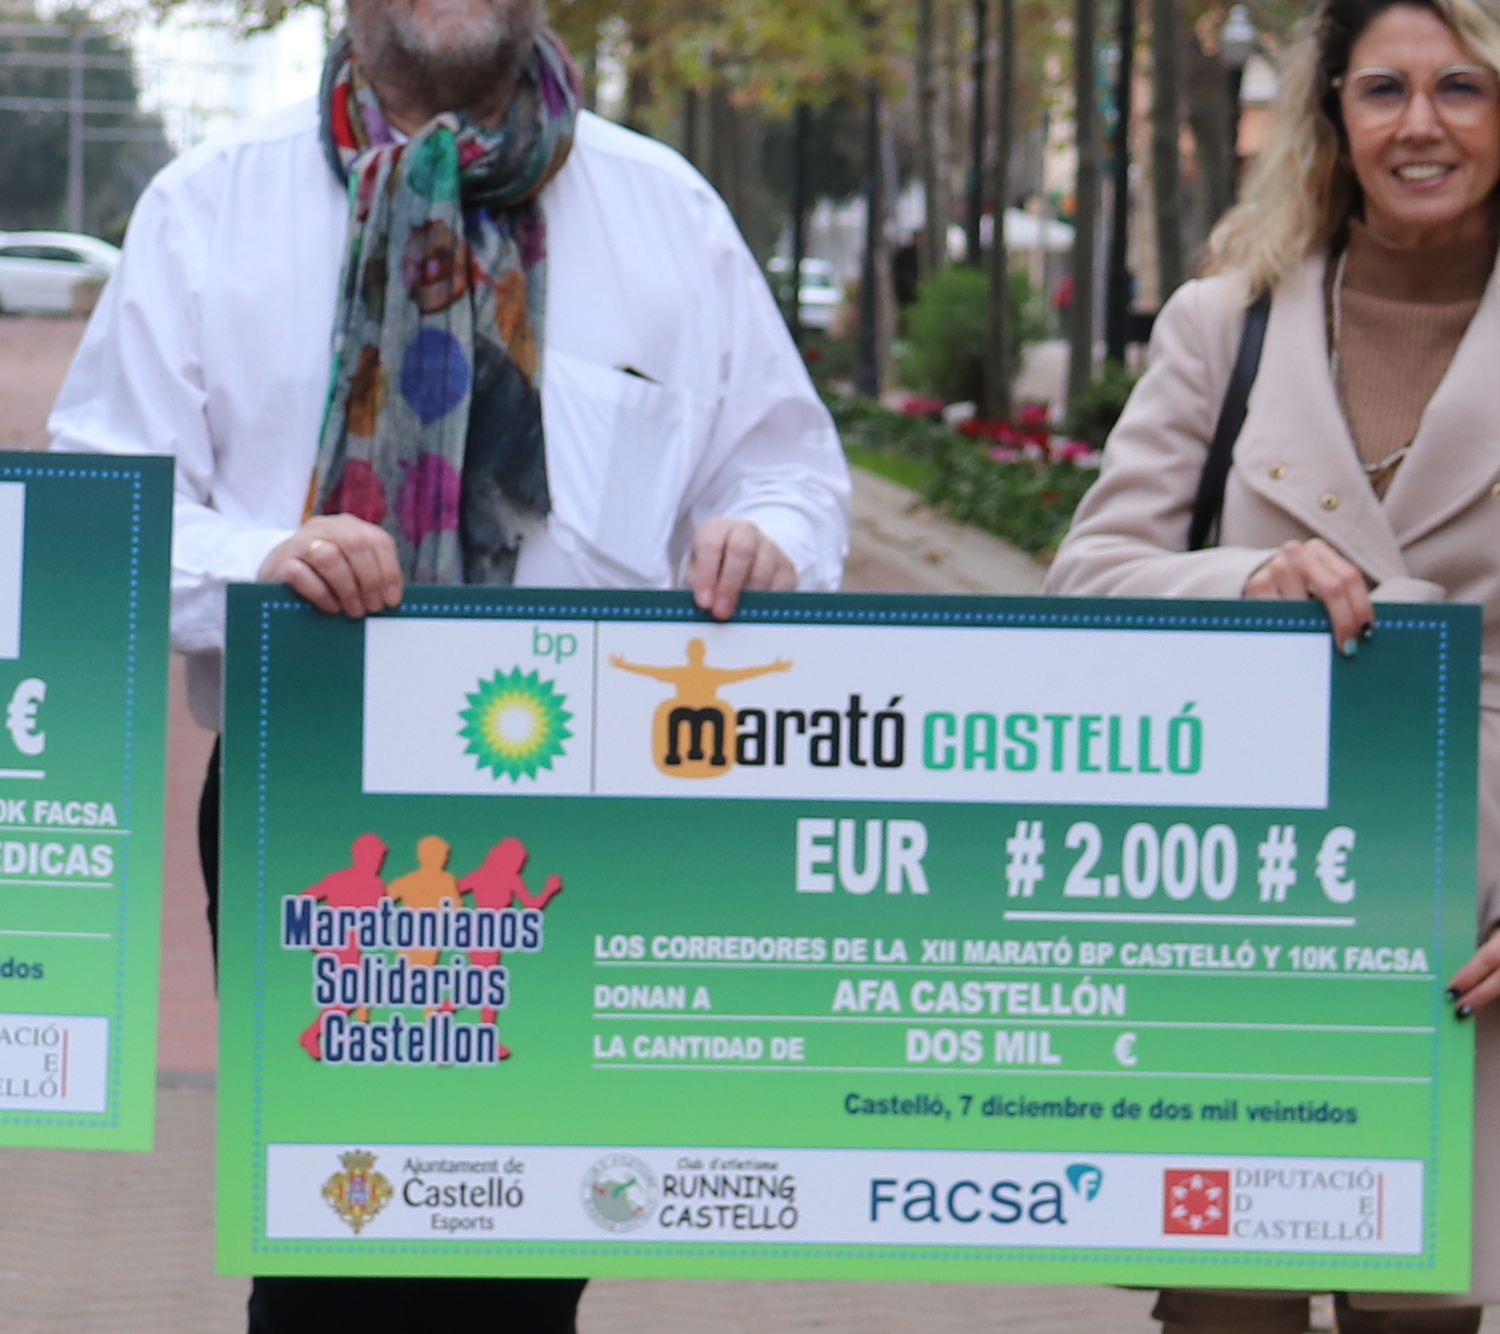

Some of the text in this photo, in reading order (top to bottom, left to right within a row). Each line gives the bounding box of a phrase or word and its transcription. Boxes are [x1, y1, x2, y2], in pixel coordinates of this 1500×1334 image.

[532, 626, 578, 663] bp
[6, 678, 47, 755] €
[664, 693, 1203, 775] marató CASTELLÓ
[33, 800, 117, 826] FACSA
[795, 817, 1356, 903] EUR # 2.000 # €
[283, 897, 541, 949] Maratonianos
[594, 934, 1429, 972] LOS CORREDORES DE LA XII MARATÓ BP CASTELLÓ Y 10K FACSA
[315, 956, 506, 1006] Solidarios
[594, 976, 1126, 1015] DONAN A AFA CASTELLÓN
[323, 1014, 496, 1063] Castellon
[593, 1029, 1137, 1067] LA CANTIDAD DE DOS MIL €
[844, 1092, 1358, 1124] Castelló, 7 diciembre de dos mil veintidos
[403, 1157, 524, 1178] Ajuntament de
[1233, 1168, 1375, 1190] DIPUTACIÓ
[402, 1178, 524, 1207] Castelló
[663, 1174, 795, 1201] RUNNING
[869, 1178, 1068, 1224] Facsa
[431, 1213, 494, 1233] Esports
[659, 1199, 798, 1229] CASTELLÓ
[1232, 1217, 1373, 1241] CASTELLÓ
